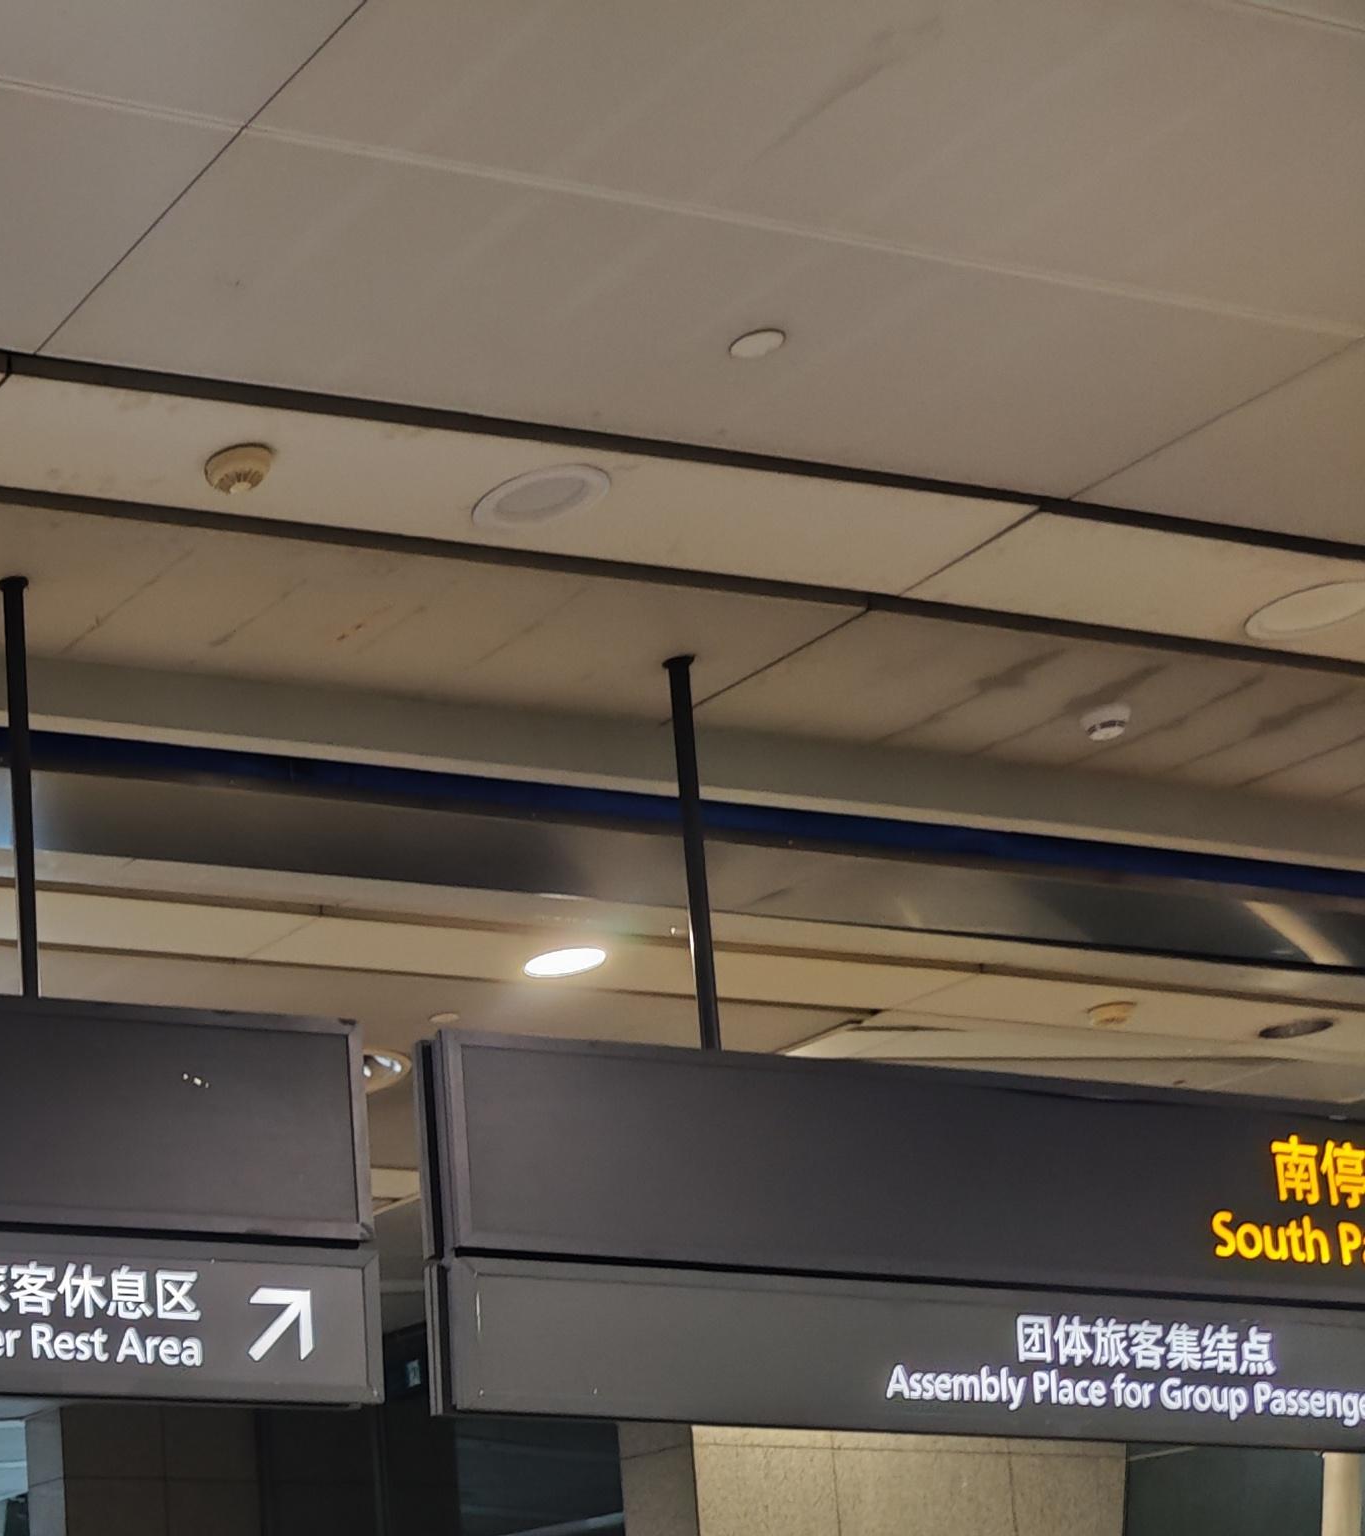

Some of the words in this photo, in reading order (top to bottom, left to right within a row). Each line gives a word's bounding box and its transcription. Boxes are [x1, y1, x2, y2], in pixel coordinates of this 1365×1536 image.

[1271, 1134, 1365, 1209] 南停
[1212, 1211, 1329, 1265] South
[1338, 1221, 1365, 1265] P
[31, 1322, 109, 1362] Rest
[116, 1329, 204, 1367] Area
[1016, 1314, 1277, 1376] 团体旅客集结点
[886, 1364, 1027, 1412] Assembly
[1033, 1370, 1107, 1407] Place
[1112, 1374, 1155, 1409] for
[1161, 1377, 1250, 1421] Group
